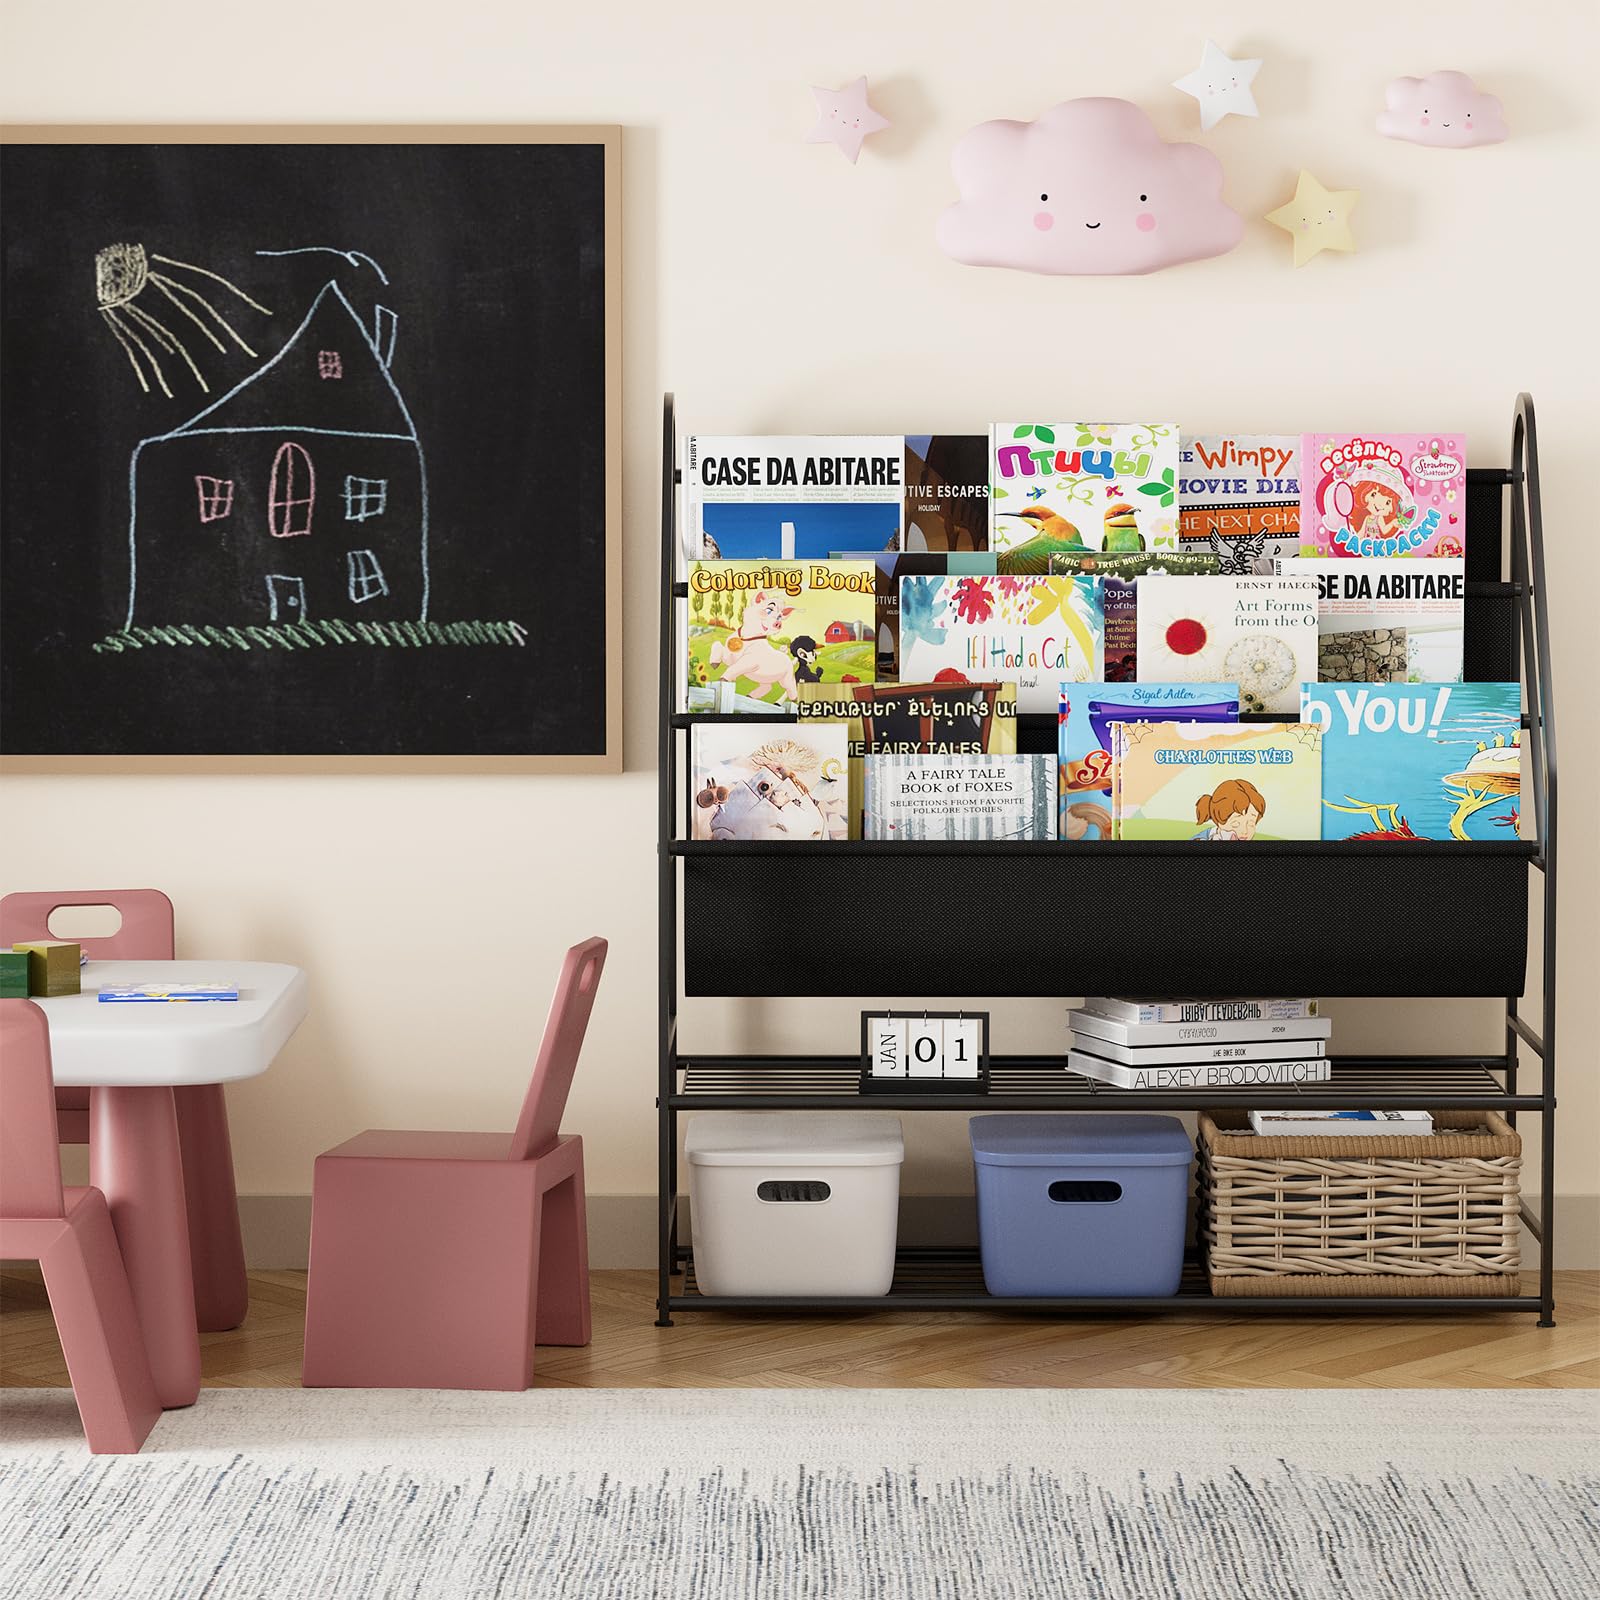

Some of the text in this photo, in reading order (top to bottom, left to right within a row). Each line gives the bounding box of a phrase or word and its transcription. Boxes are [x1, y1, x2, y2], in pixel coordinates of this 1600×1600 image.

[689, 443, 697, 470] ABITARE
[997, 445, 1152, 479] Птицы
[1179, 440, 1294, 478] E Wimpy
[702, 456, 900, 486] CASE DA ABITARE
[1415, 458, 1457, 474] Strawberry
[937, 485, 989, 498] ESCAPES
[1256, 479, 1300, 494] DIA
[917, 504, 941, 512] HOLIDAY
[1206, 514, 1255, 529] NEXT
[1260, 513, 1300, 528] CHA
[1335, 508, 1441, 558] РАСКРАСКИ
[1053, 552, 1214, 569] MAGIC TREE HOUSE BOOKS #9-12
[690, 565, 875, 597] Coloring Book
[1235, 582, 1318, 590] ERNST HAECK
[1344, 575, 1372, 599] DA
[1376, 575, 1464, 599] ABITARE
[1113, 602, 1124, 610] of
[1235, 599, 1258, 611] Art
[1265, 599, 1313, 611] Forms
[1235, 614, 1318, 627] from the O
[1105, 634, 1131, 642] chtime
[967, 634, 1072, 669] If I Had a Cat
[1132, 688, 1197, 704] Sigal Adler
[872, 742, 922, 754] FAIRY
[927, 742, 982, 754] TALES
[1154, 747, 1294, 765] CHARLOTTES WEB
[906, 768, 1006, 780] A FAIRY TALE
[900, 781, 1013, 794] BOOK of FOXES
[890, 799, 949, 808] SELECTIONS
[979, 798, 1025, 806] FAVORITE
[913, 806, 1003, 815] FOLKLORE STORIES
[880, 1033, 897, 1070] JAN
[1134, 1068, 1202, 1089] ALEXEY
[1207, 1063, 1318, 1086] BRODOVITCH
